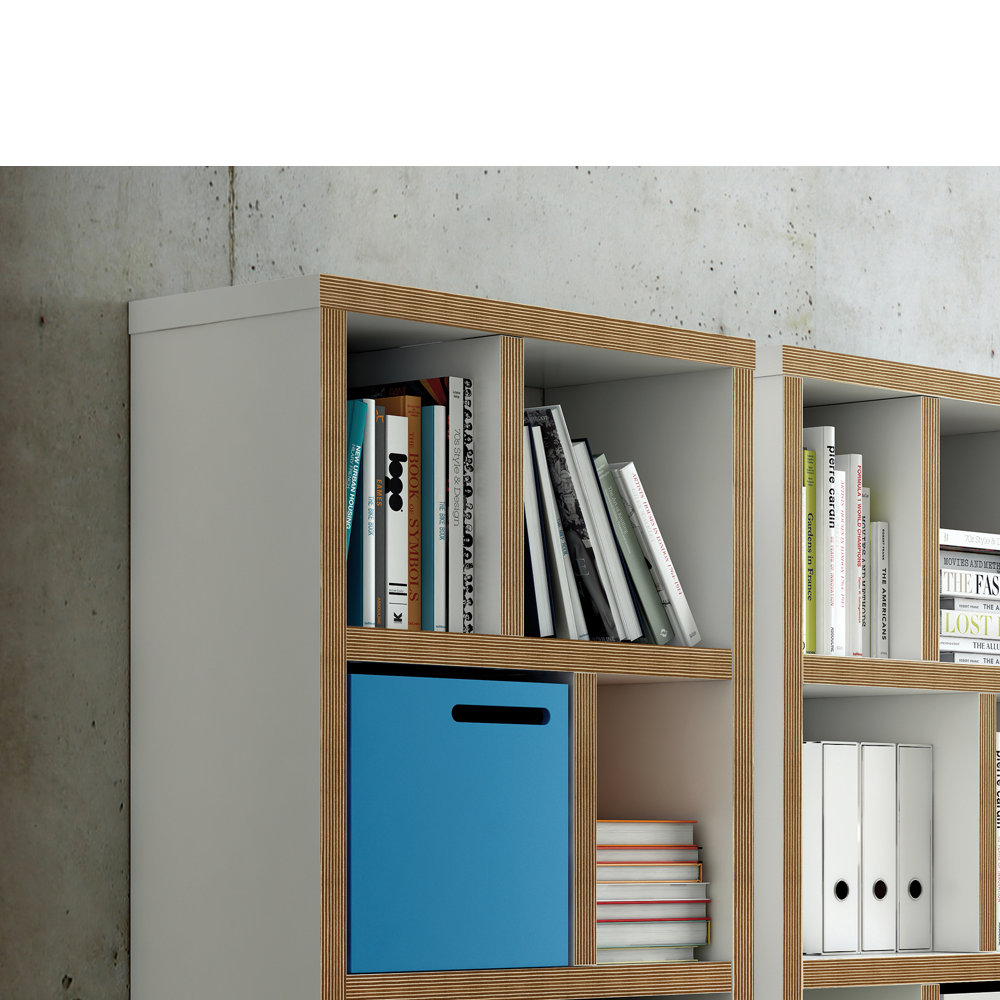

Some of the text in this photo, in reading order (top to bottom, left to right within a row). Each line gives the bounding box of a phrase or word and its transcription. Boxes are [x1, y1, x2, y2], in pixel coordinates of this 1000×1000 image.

[409, 453, 419, 490] BOOK
[453, 448, 461, 474] Style
[827, 446, 835, 484] pierre
[350, 465, 359, 493] URBAN
[346, 493, 355, 530] HOUSING
[453, 487, 461, 527] Design
[409, 519, 419, 602] SYMBOLS
[656, 536, 669, 562] LONDON
[808, 556, 814, 565] in
[944, 557, 969, 567] MOVIES
[970, 560, 982, 569] AND
[944, 572, 973, 593] THE
[946, 612, 993, 636] LOST
[973, 642, 986, 650] THE
